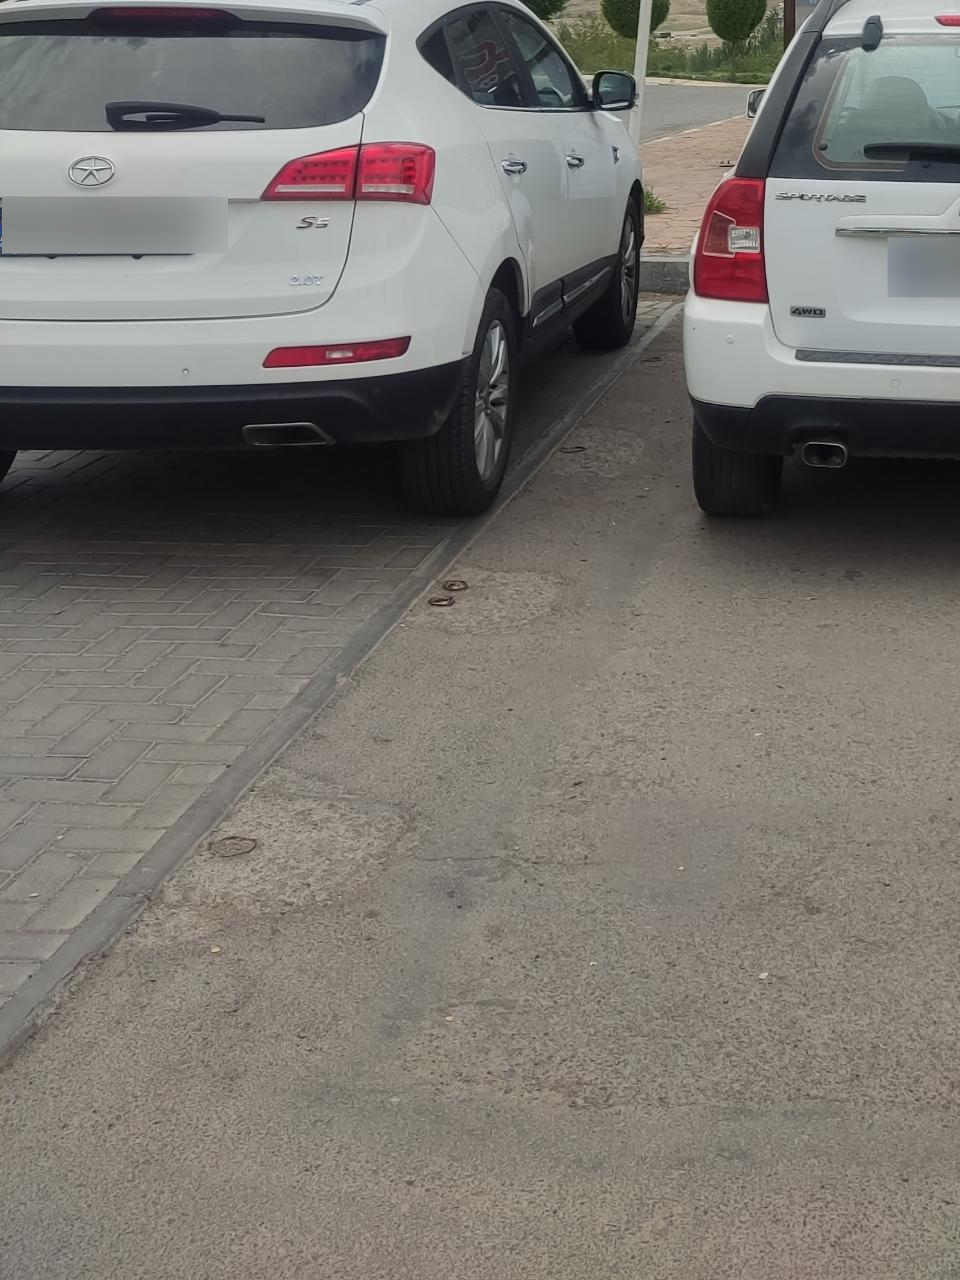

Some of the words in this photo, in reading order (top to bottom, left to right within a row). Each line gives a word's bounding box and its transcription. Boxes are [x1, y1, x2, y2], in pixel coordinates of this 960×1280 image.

[775, 191, 867, 203] SPORTAGE
[296, 216, 331, 230] S5
[791, 307, 824, 317] 4WD
